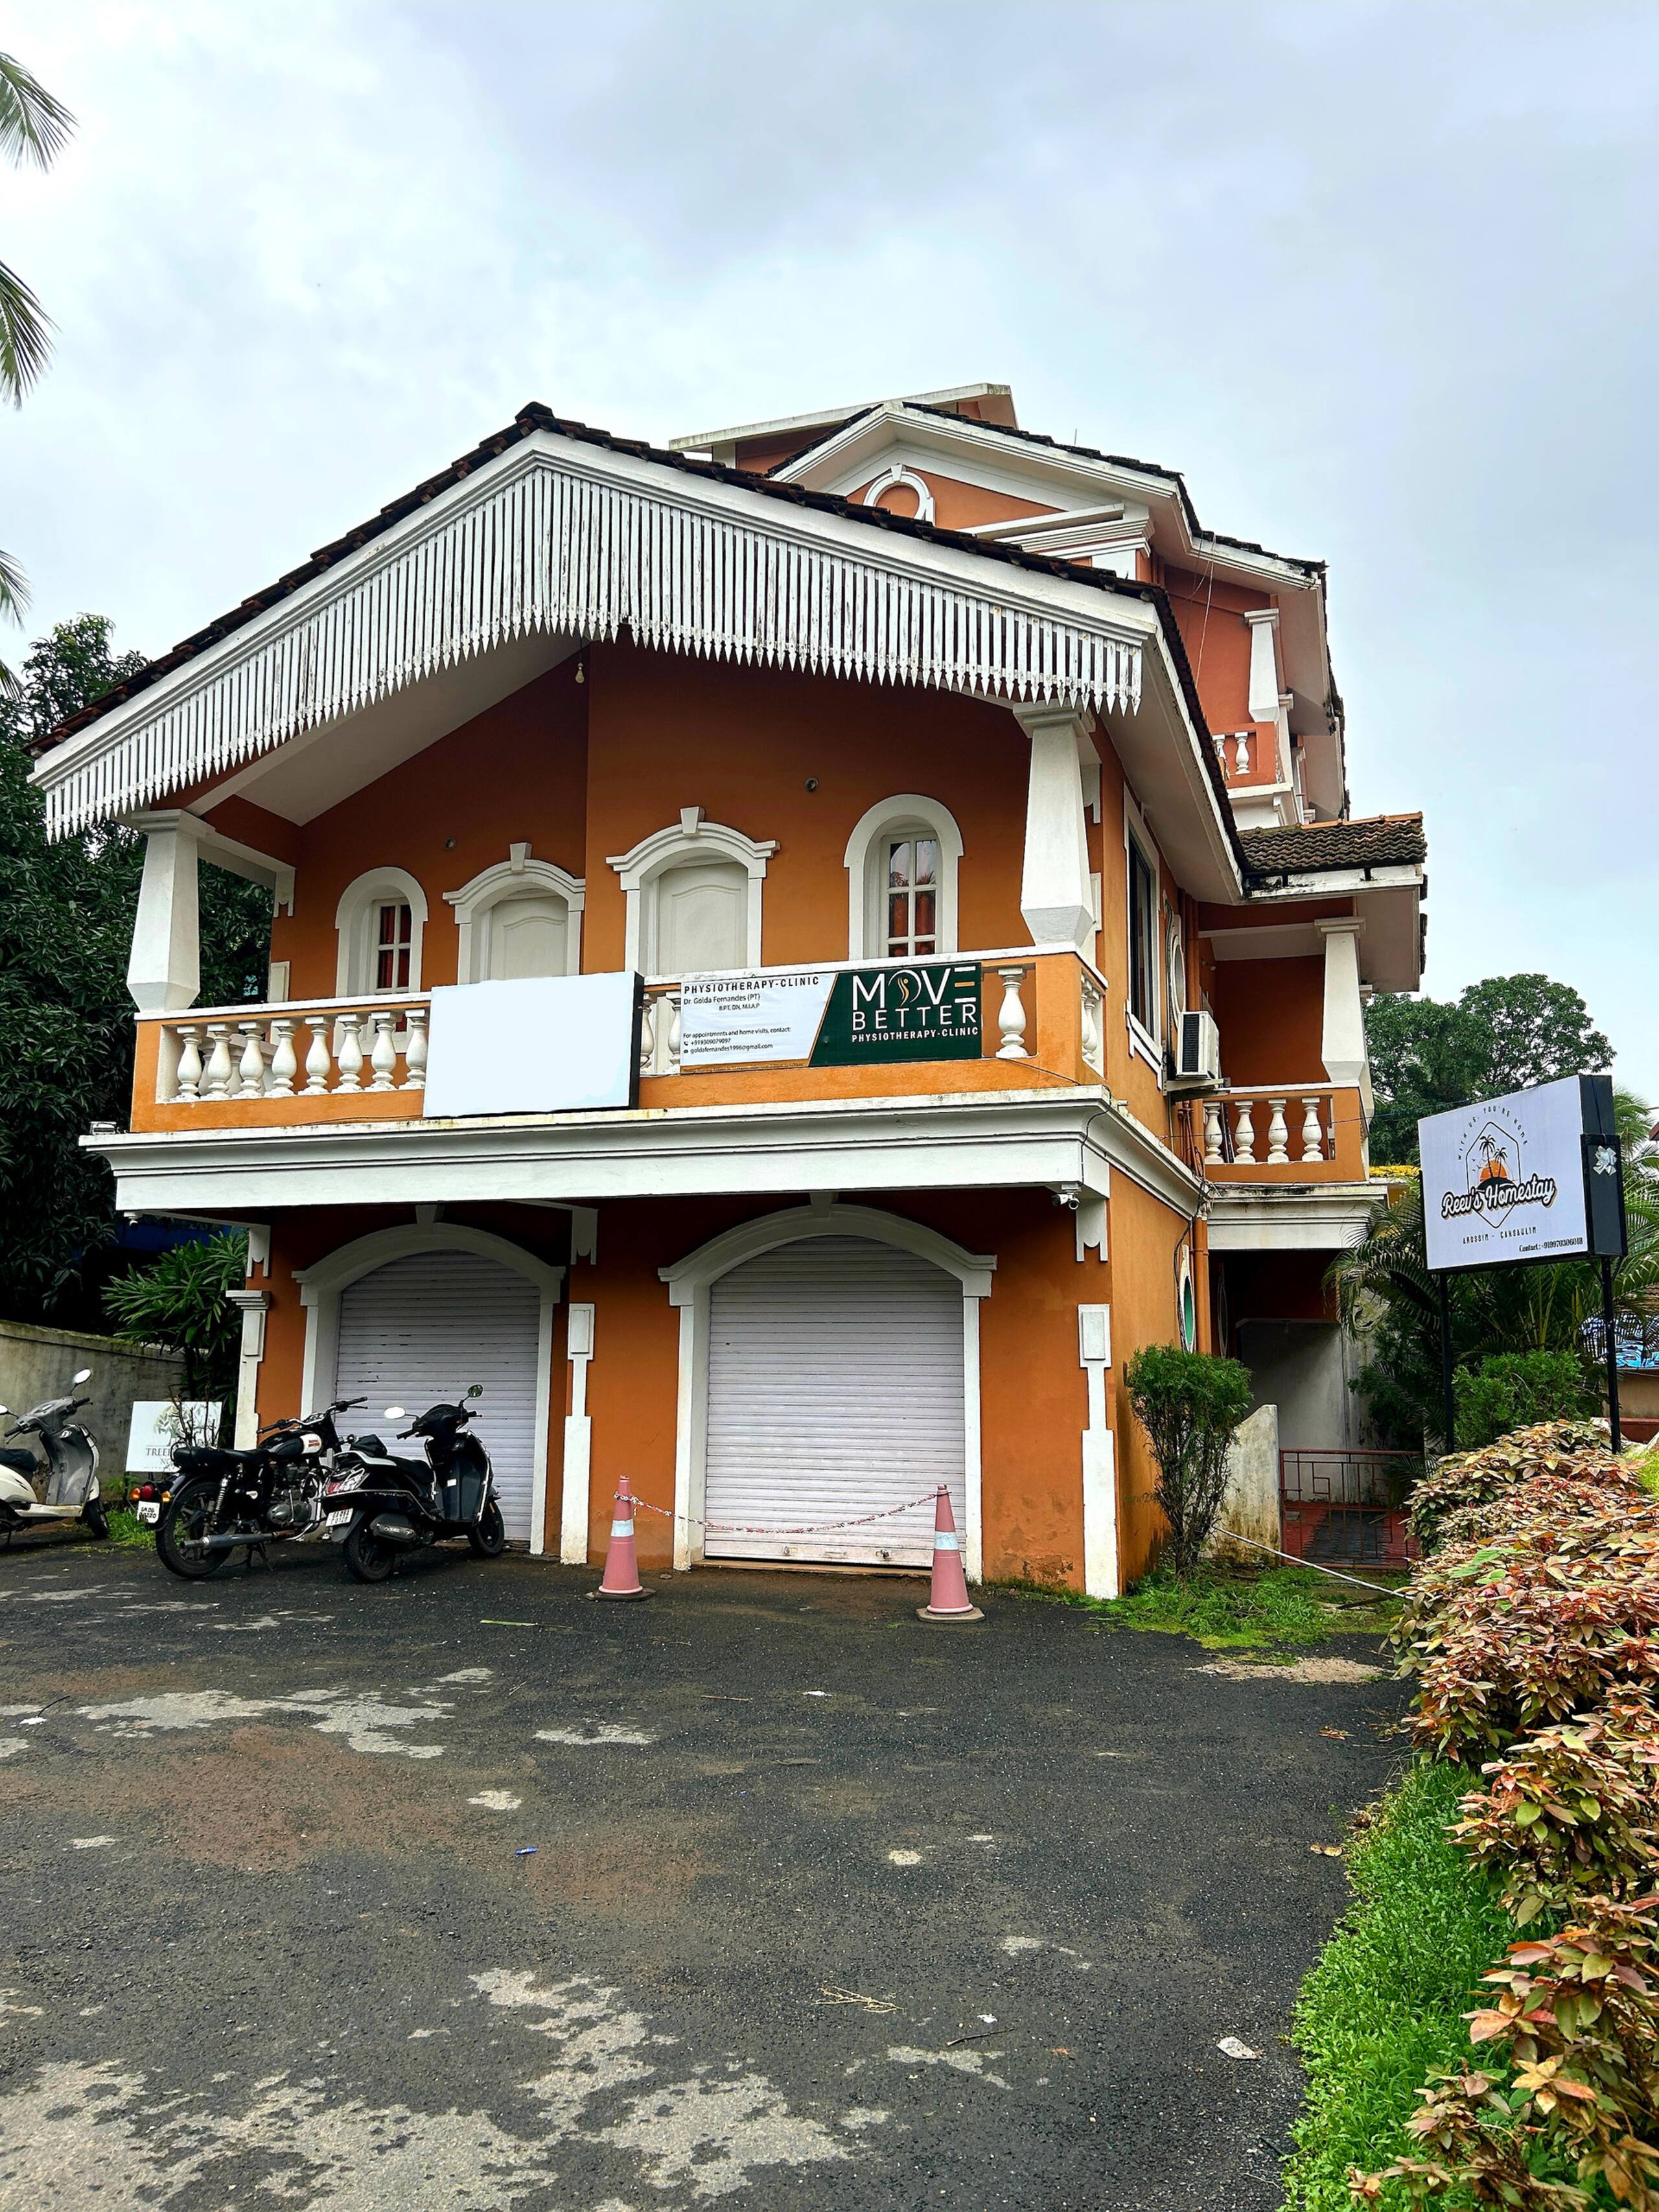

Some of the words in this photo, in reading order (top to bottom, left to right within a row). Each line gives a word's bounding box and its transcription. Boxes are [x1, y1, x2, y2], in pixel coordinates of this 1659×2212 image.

[684, 977, 819, 994] PHYSIOTHERAPY-CLINIC
[693, 995, 712, 1004] Golda
[713, 994, 746, 1003] Fernandes
[748, 993, 760, 1001] (PT)
[853, 1004, 977, 1031] BETTER
[691, 1030, 727, 1040] appointments
[852, 1027, 979, 1043] PHYSIOTHERAPY-CLINIC
[690, 1043, 773, 1054] goldafernandes1996@gmail.com
[1457, 1133, 1467, 1160] WITH
[1514, 1118, 1528, 1145] HOME
[1442, 1187, 1482, 1217] Reev's
[1485, 1175, 1555, 1206] Homestay
[1463, 1234, 1489, 1244] AROSSIM
[1500, 1226, 1537, 1238] CANSAULIM
